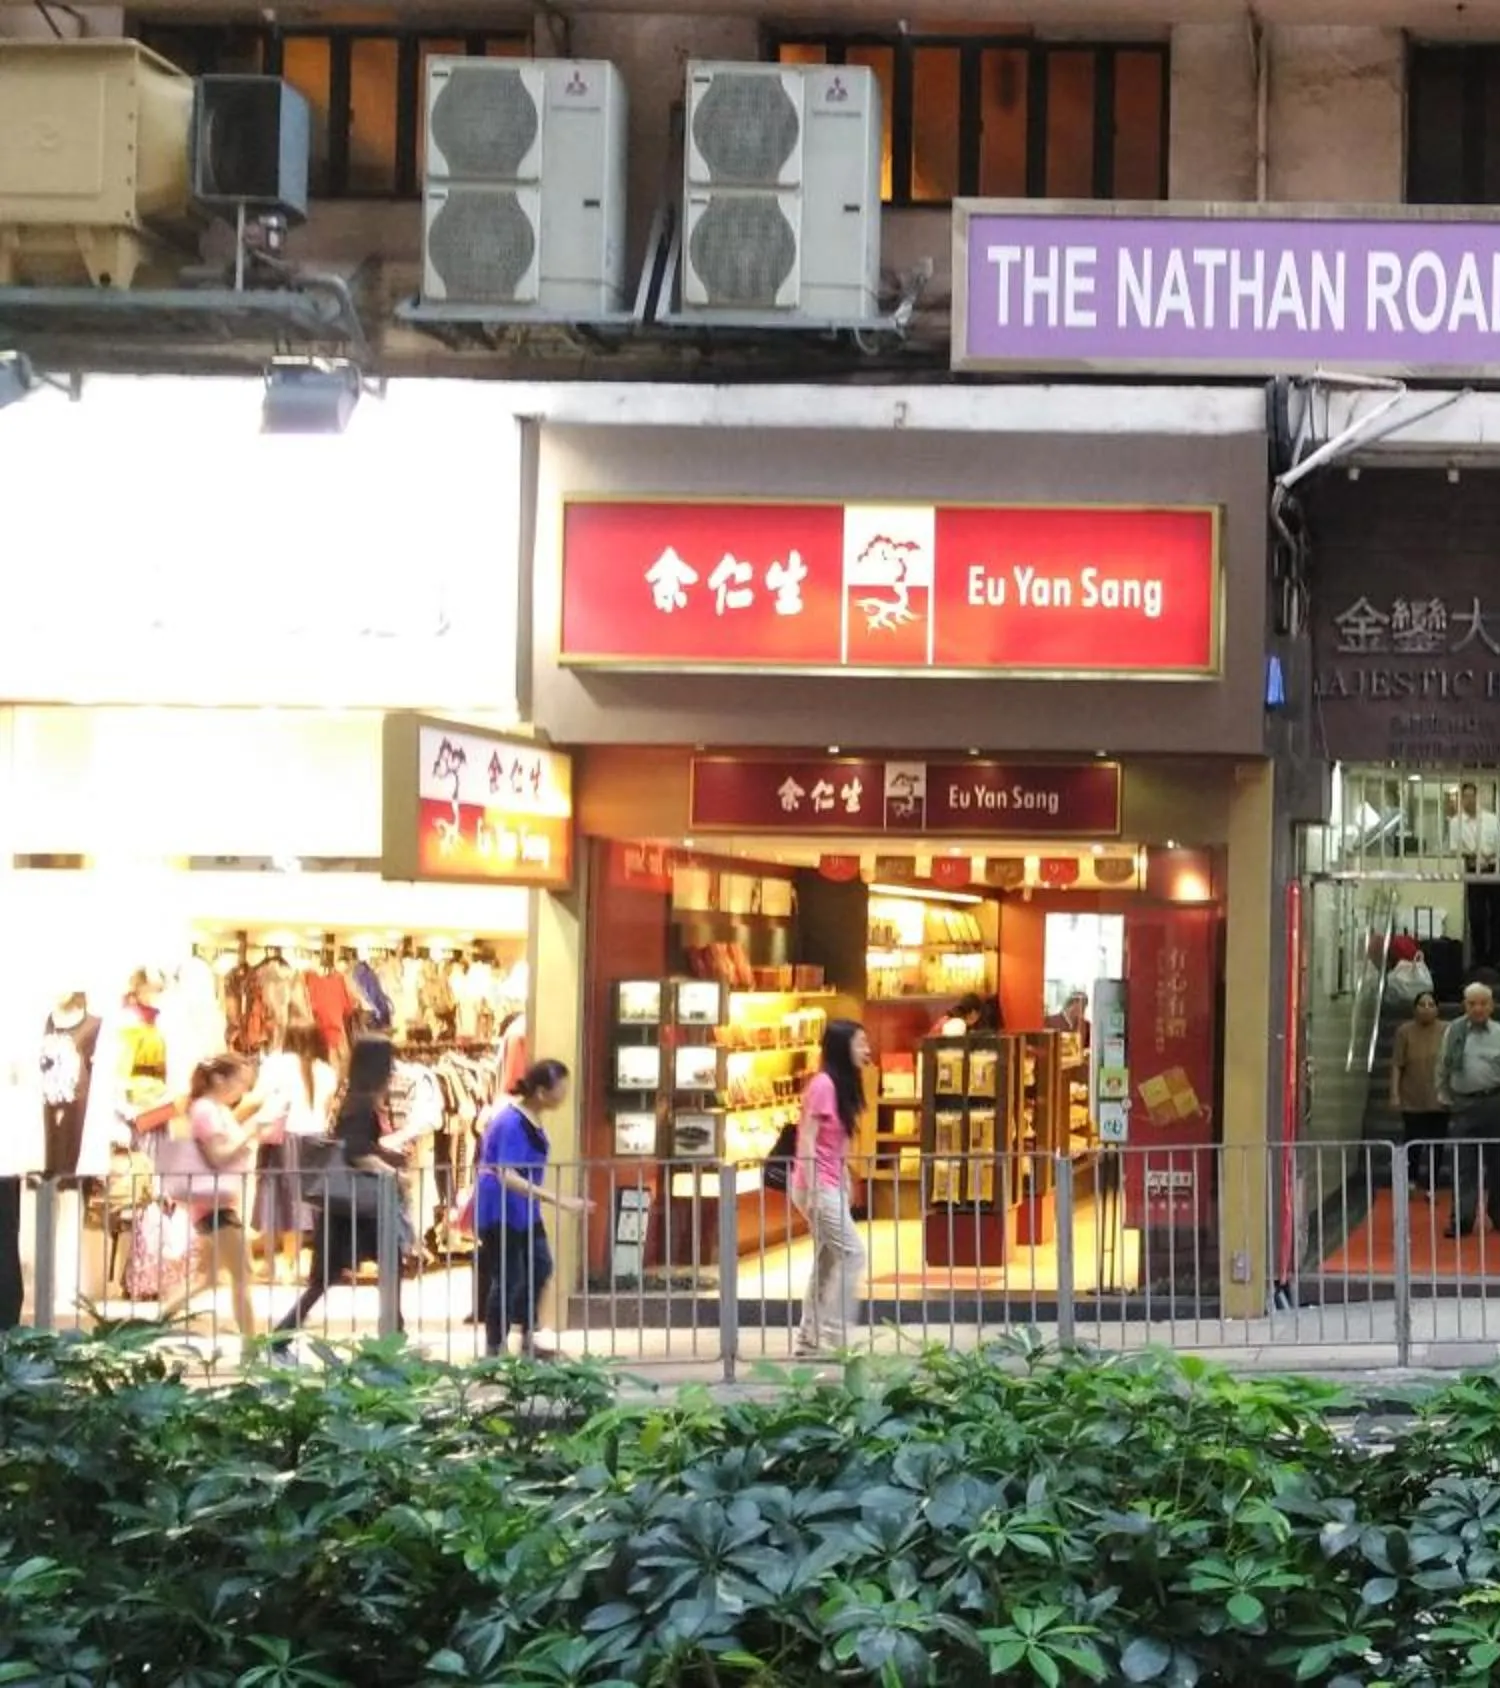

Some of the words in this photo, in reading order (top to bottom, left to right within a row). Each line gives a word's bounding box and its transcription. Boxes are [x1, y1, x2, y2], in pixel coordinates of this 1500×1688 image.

[988, 246, 1097, 328] THE
[1117, 247, 1345, 331] NATHAN
[645, 546, 809, 616] 余仁生
[967, 565, 1003, 606] Eu
[1012, 566, 1073, 608] Yan
[1081, 566, 1163, 618] Sang
[777, 776, 864, 813] 余仁生
[949, 785, 971, 809] Eu
[975, 785, 1008, 809] Yan
[1012, 785, 1059, 816] Sang
